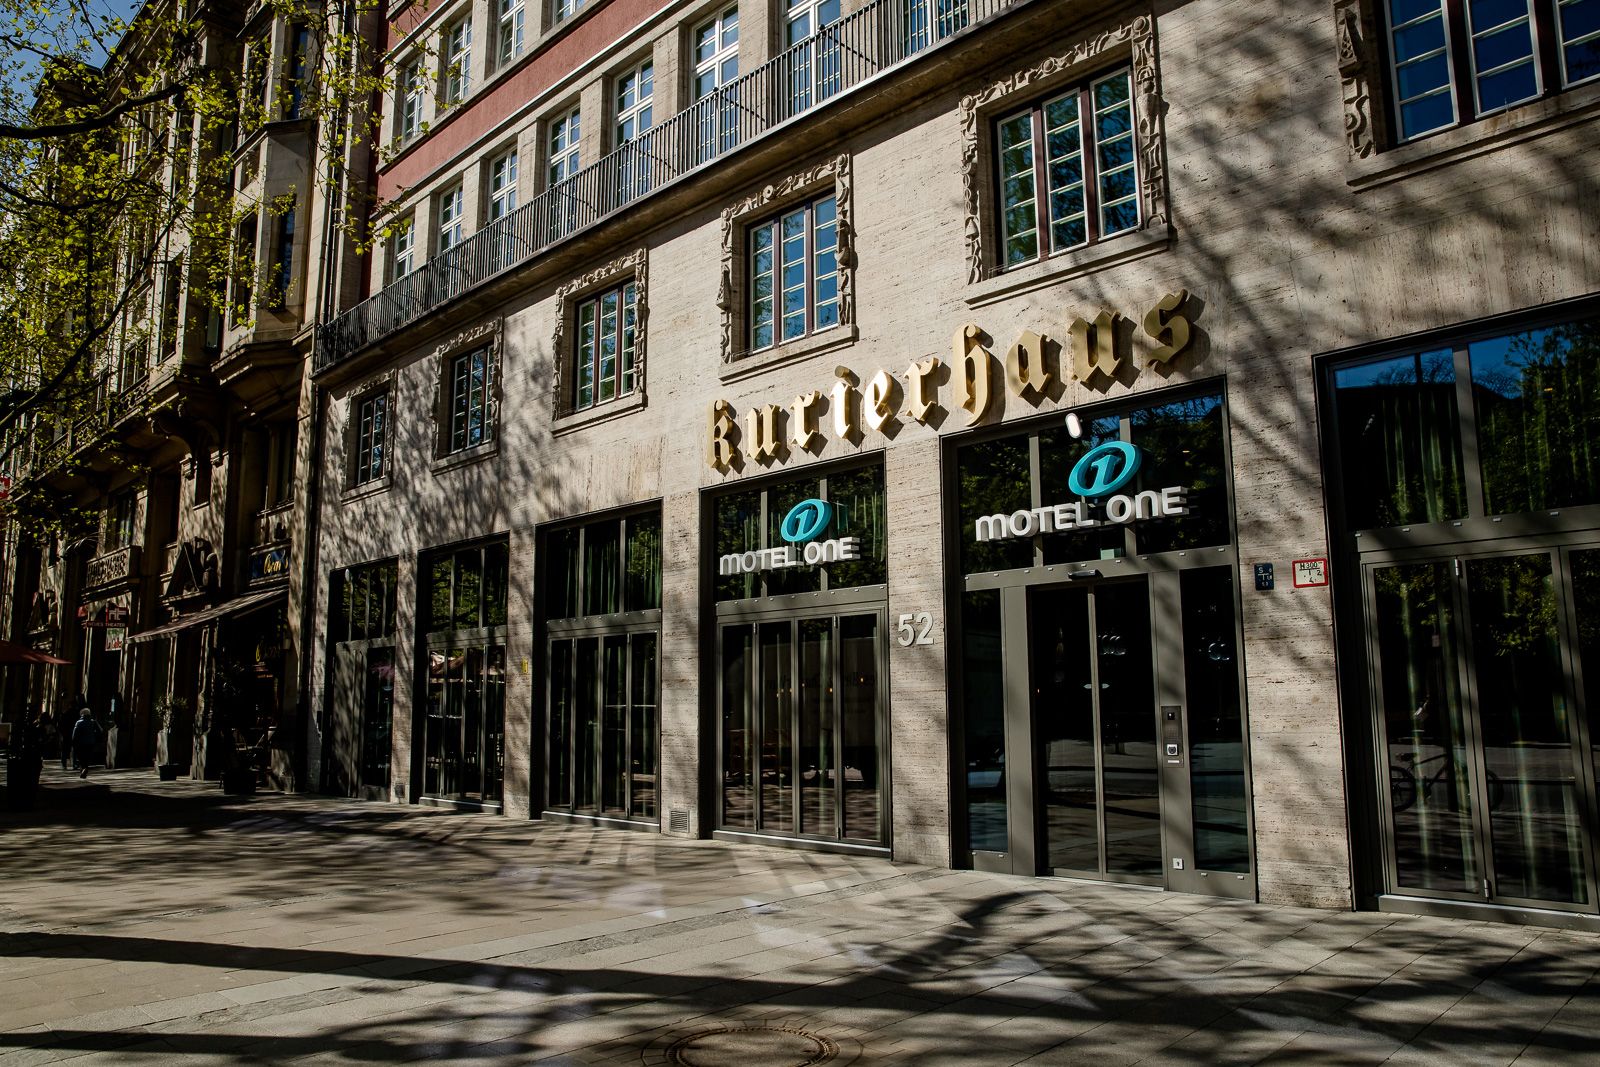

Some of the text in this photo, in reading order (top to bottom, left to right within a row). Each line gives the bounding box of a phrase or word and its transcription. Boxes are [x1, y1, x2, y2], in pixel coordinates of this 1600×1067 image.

[975, 485, 1190, 542] MOTEL ONE
[719, 536, 861, 576] MOTEL ONE
[897, 611, 935, 647] 52
